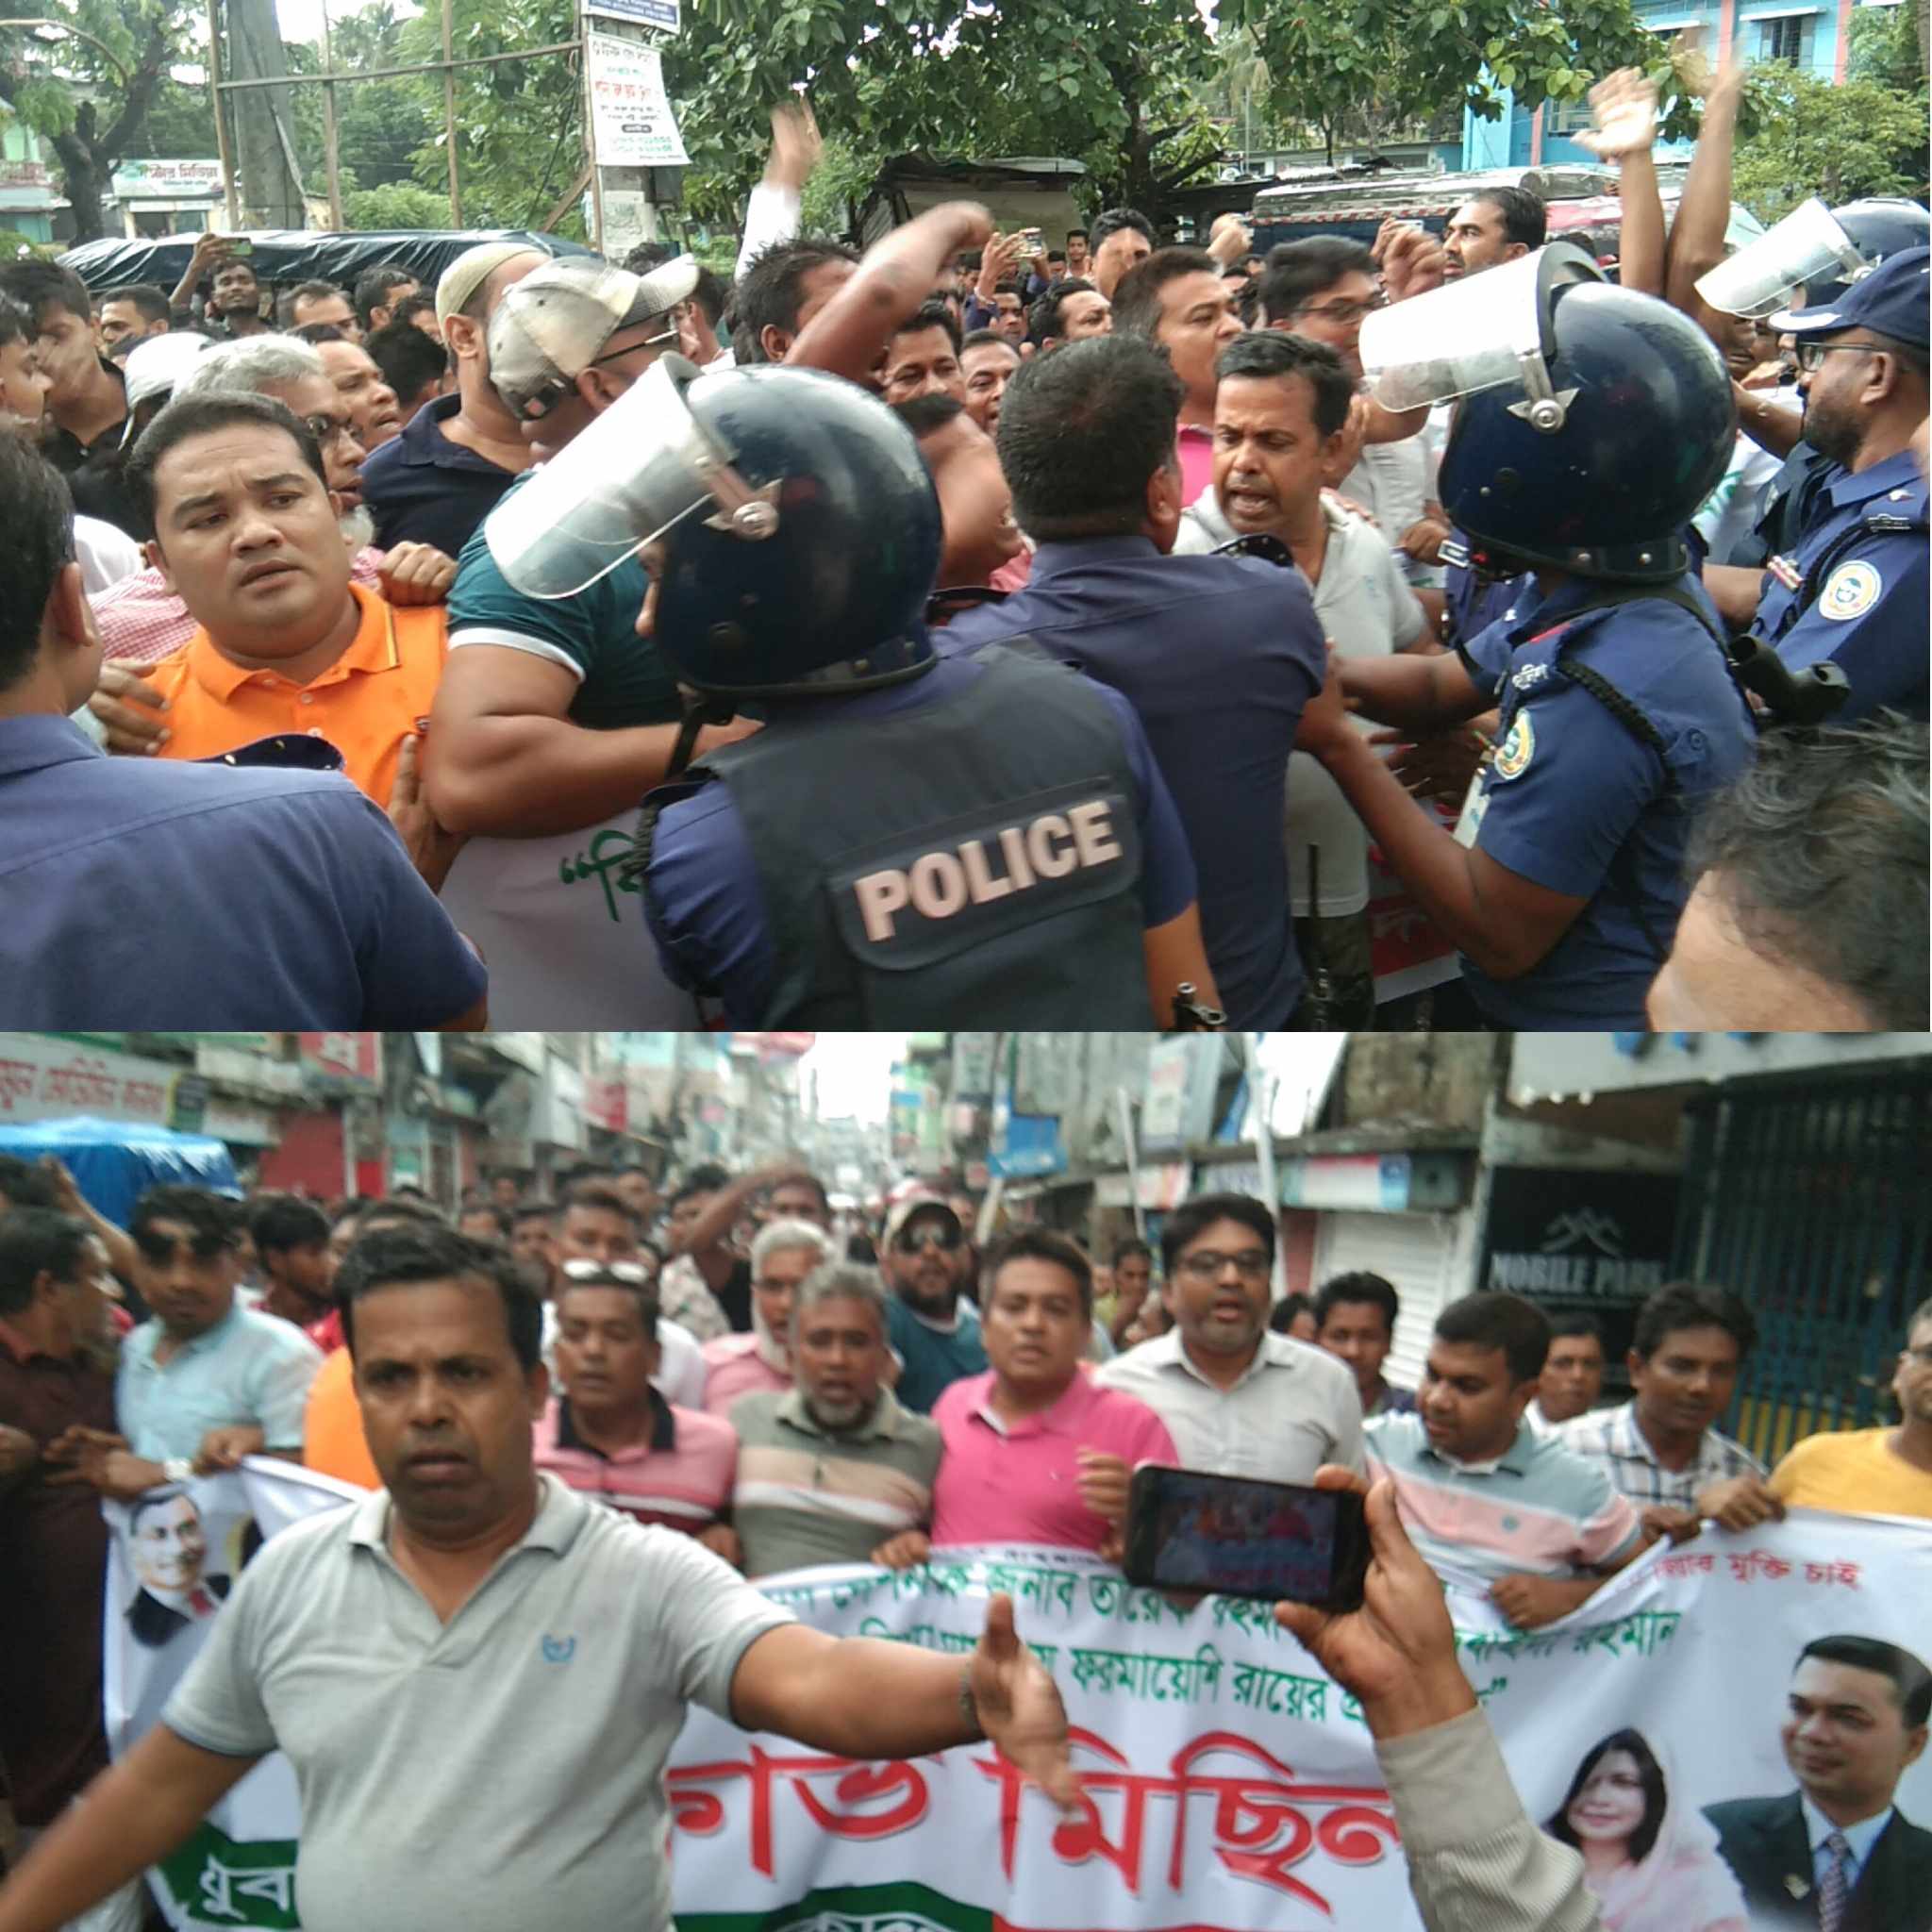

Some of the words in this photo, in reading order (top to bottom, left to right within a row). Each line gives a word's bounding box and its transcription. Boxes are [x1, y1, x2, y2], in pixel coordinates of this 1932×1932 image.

[854, 800, 1124, 942] POLICE
[1804, 1559, 1862, 1591] চাই
[1233, 1661, 1329, 1721] রায়ের
